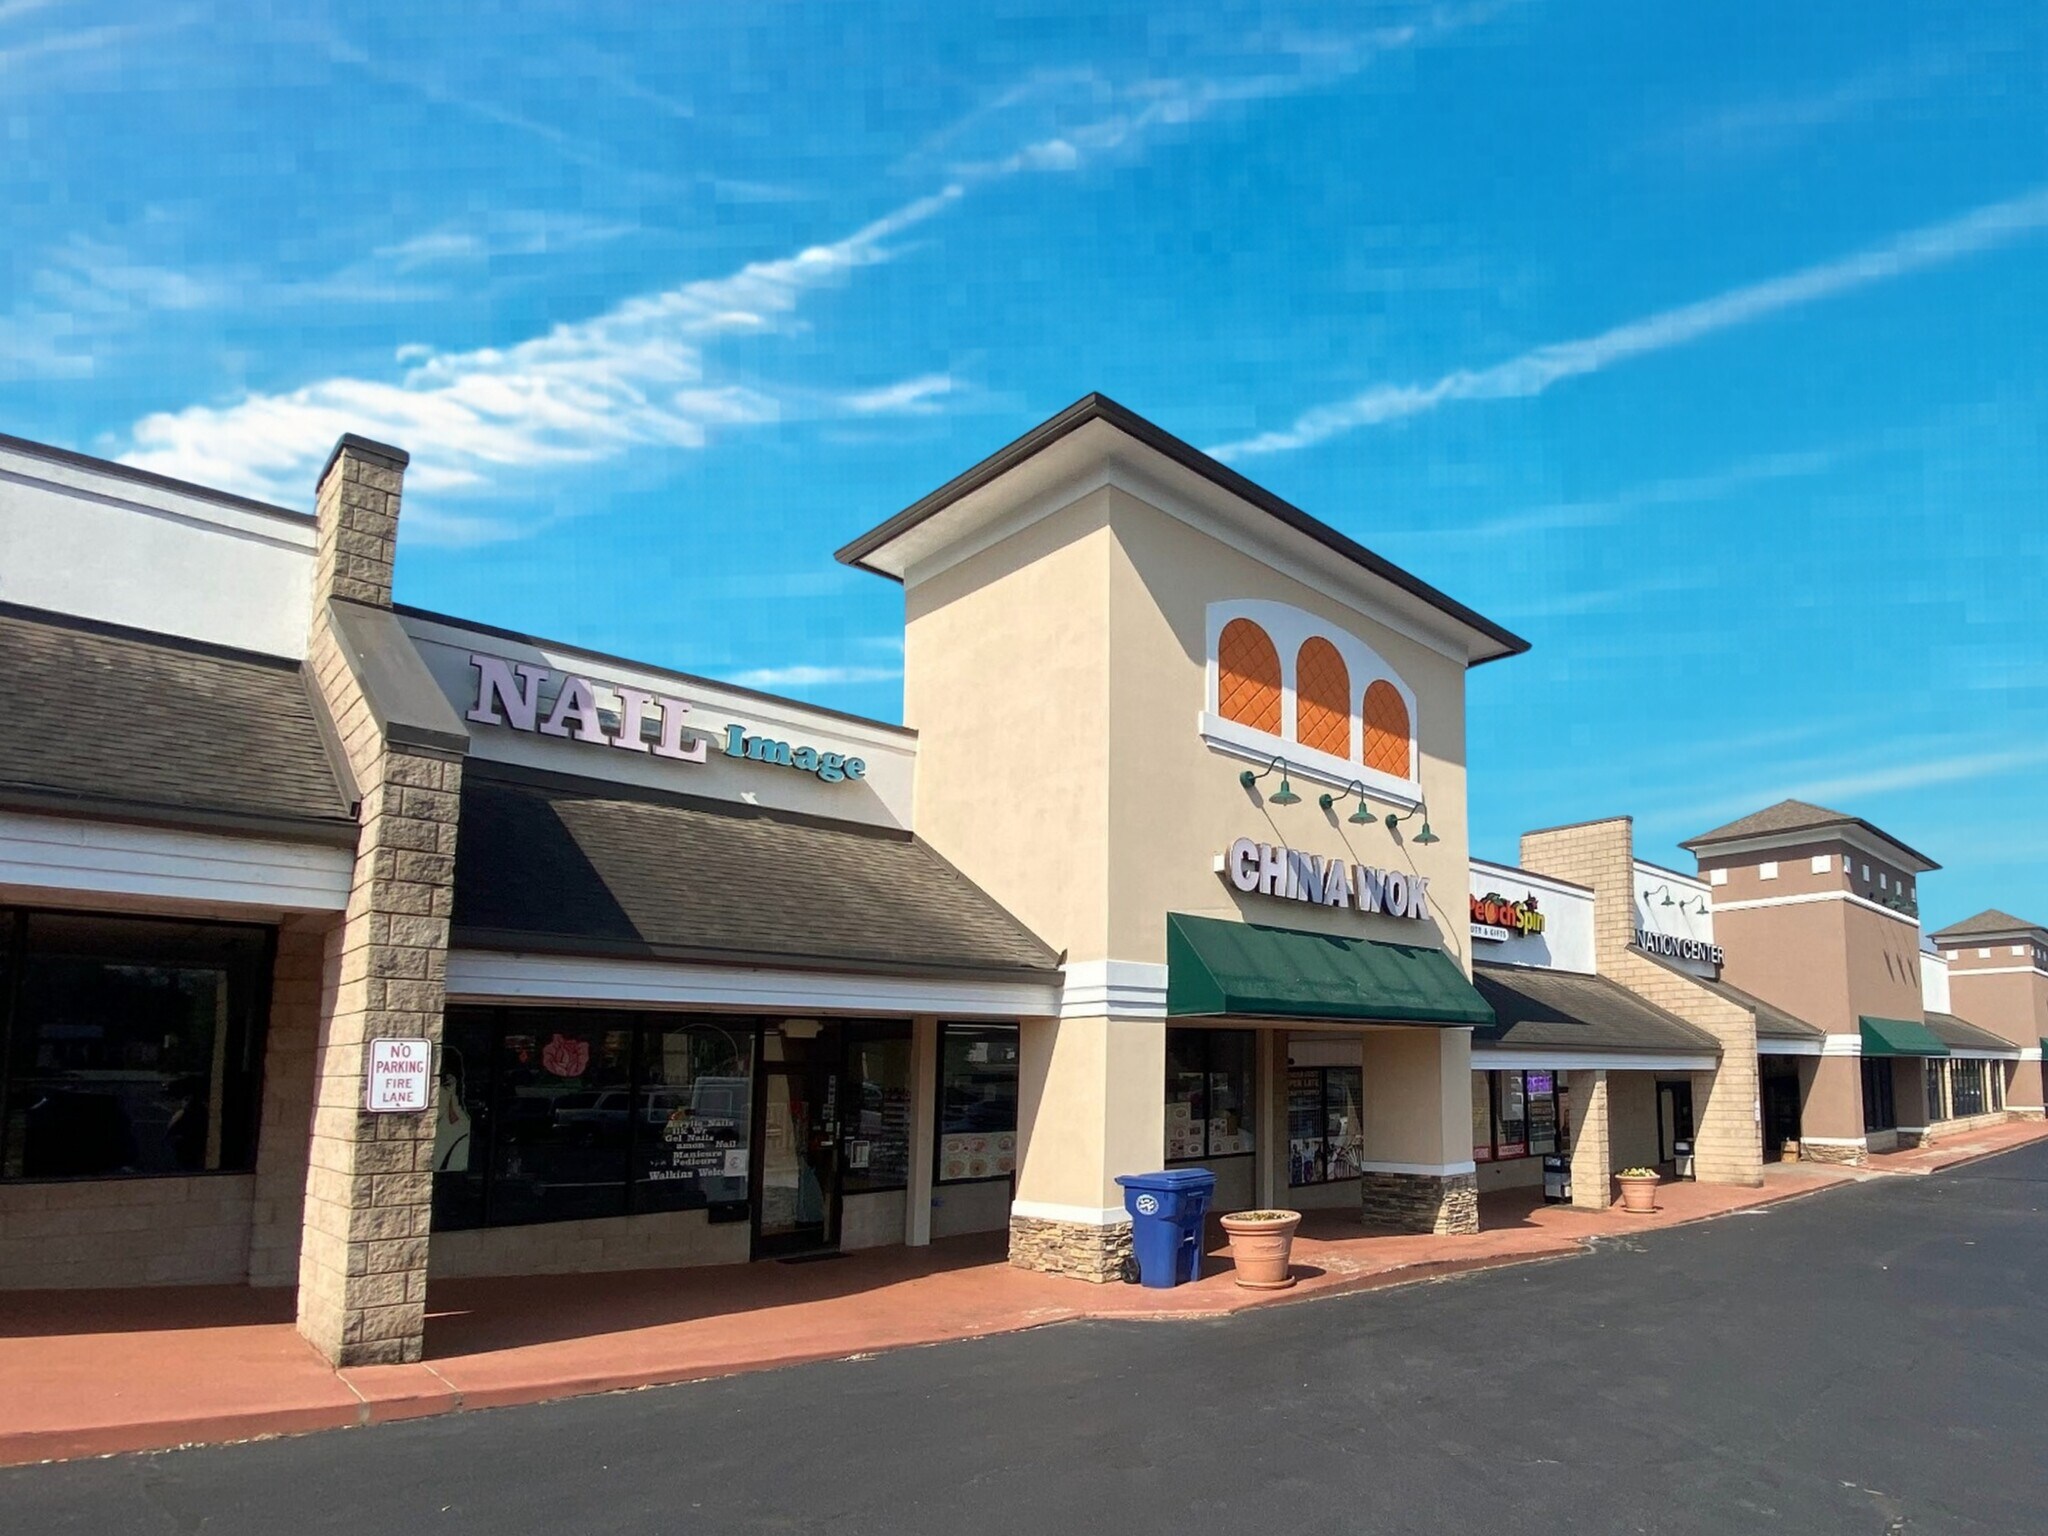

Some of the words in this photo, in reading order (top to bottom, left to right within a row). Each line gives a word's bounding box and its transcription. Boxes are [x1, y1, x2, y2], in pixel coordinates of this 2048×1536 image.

[466, 654, 707, 763] NAIL
[722, 723, 866, 783] Image
[1228, 837, 1349, 908] CHINA
[1353, 864, 1430, 920] WOK
[1682, 938, 1725, 964] CENTER
[390, 1045, 411, 1058] NO
[375, 1061, 424, 1073] PARKING
[385, 1078, 413, 1089] FIRE
[382, 1091, 414, 1103] LANE
[665, 1134, 682, 1142] Gel
[687, 1133, 714, 1142] Nails
[673, 1150, 722, 1159] Manicure
[673, 1158, 717, 1166] Pedicure
[649, 1170, 693, 1180] Walkins
